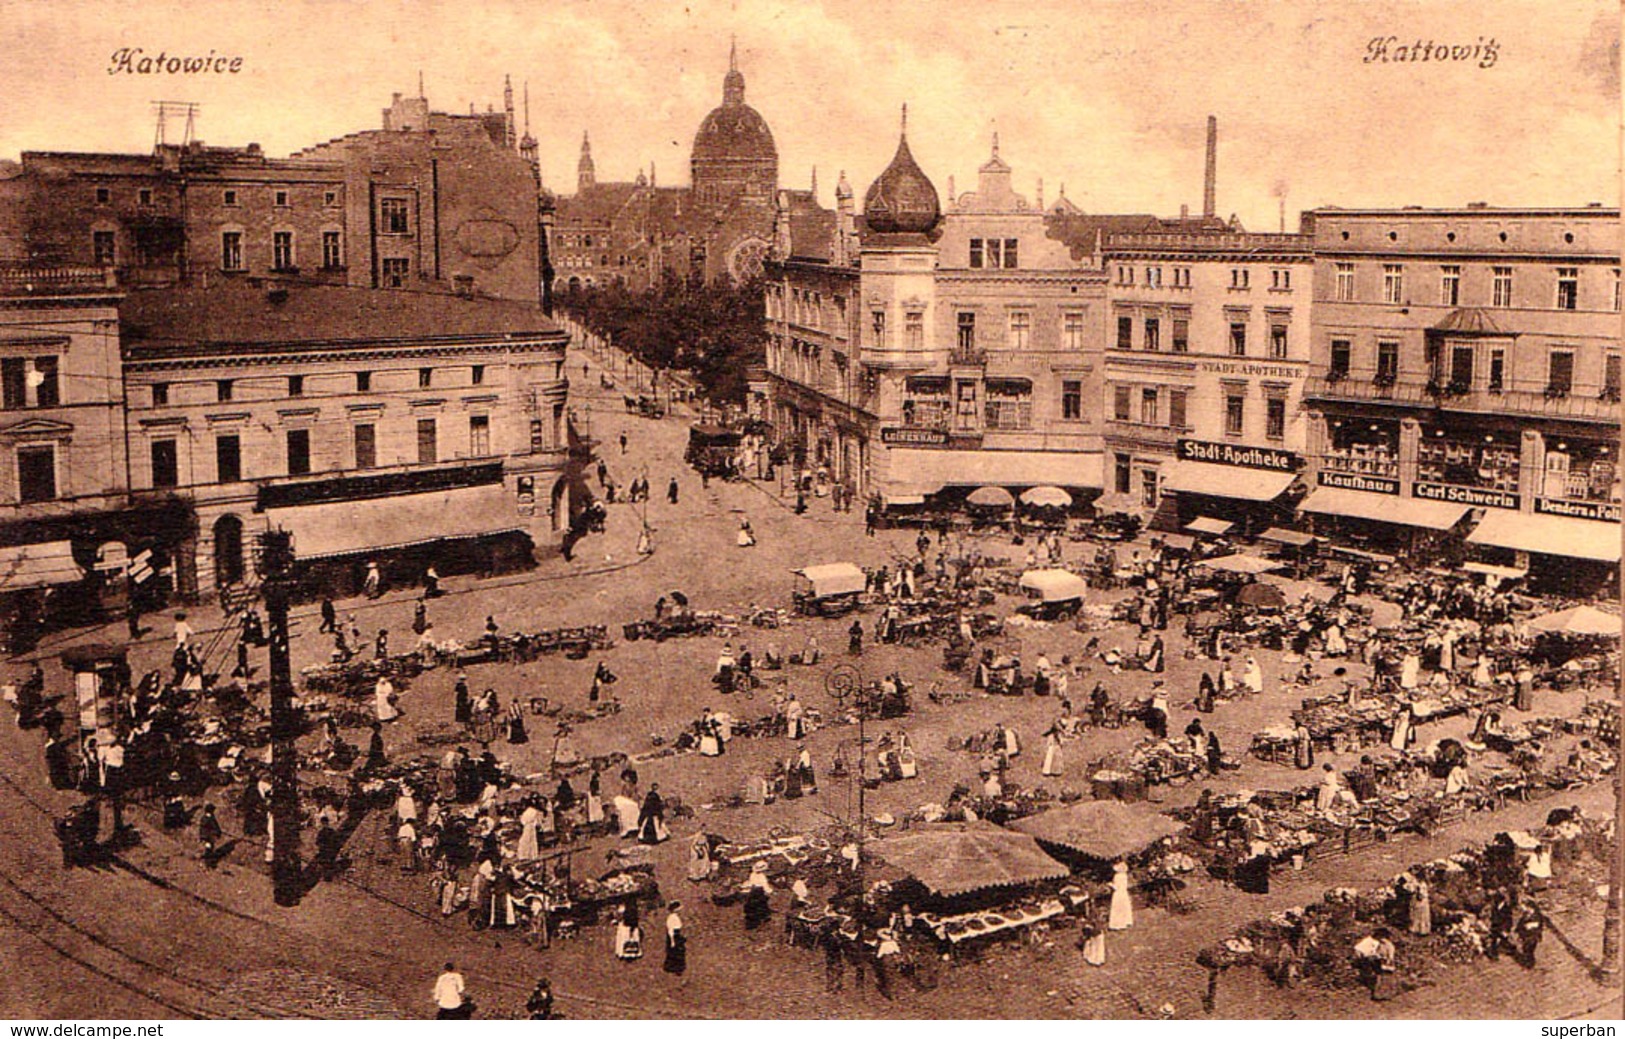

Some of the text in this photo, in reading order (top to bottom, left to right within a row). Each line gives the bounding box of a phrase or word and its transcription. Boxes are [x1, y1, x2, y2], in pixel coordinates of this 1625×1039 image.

[1185, 441, 1289, 468] Stadt-Apotheke
[1323, 473, 1395, 492] Kaufhaus
[1417, 484, 1515, 507] Carl Schwerin
